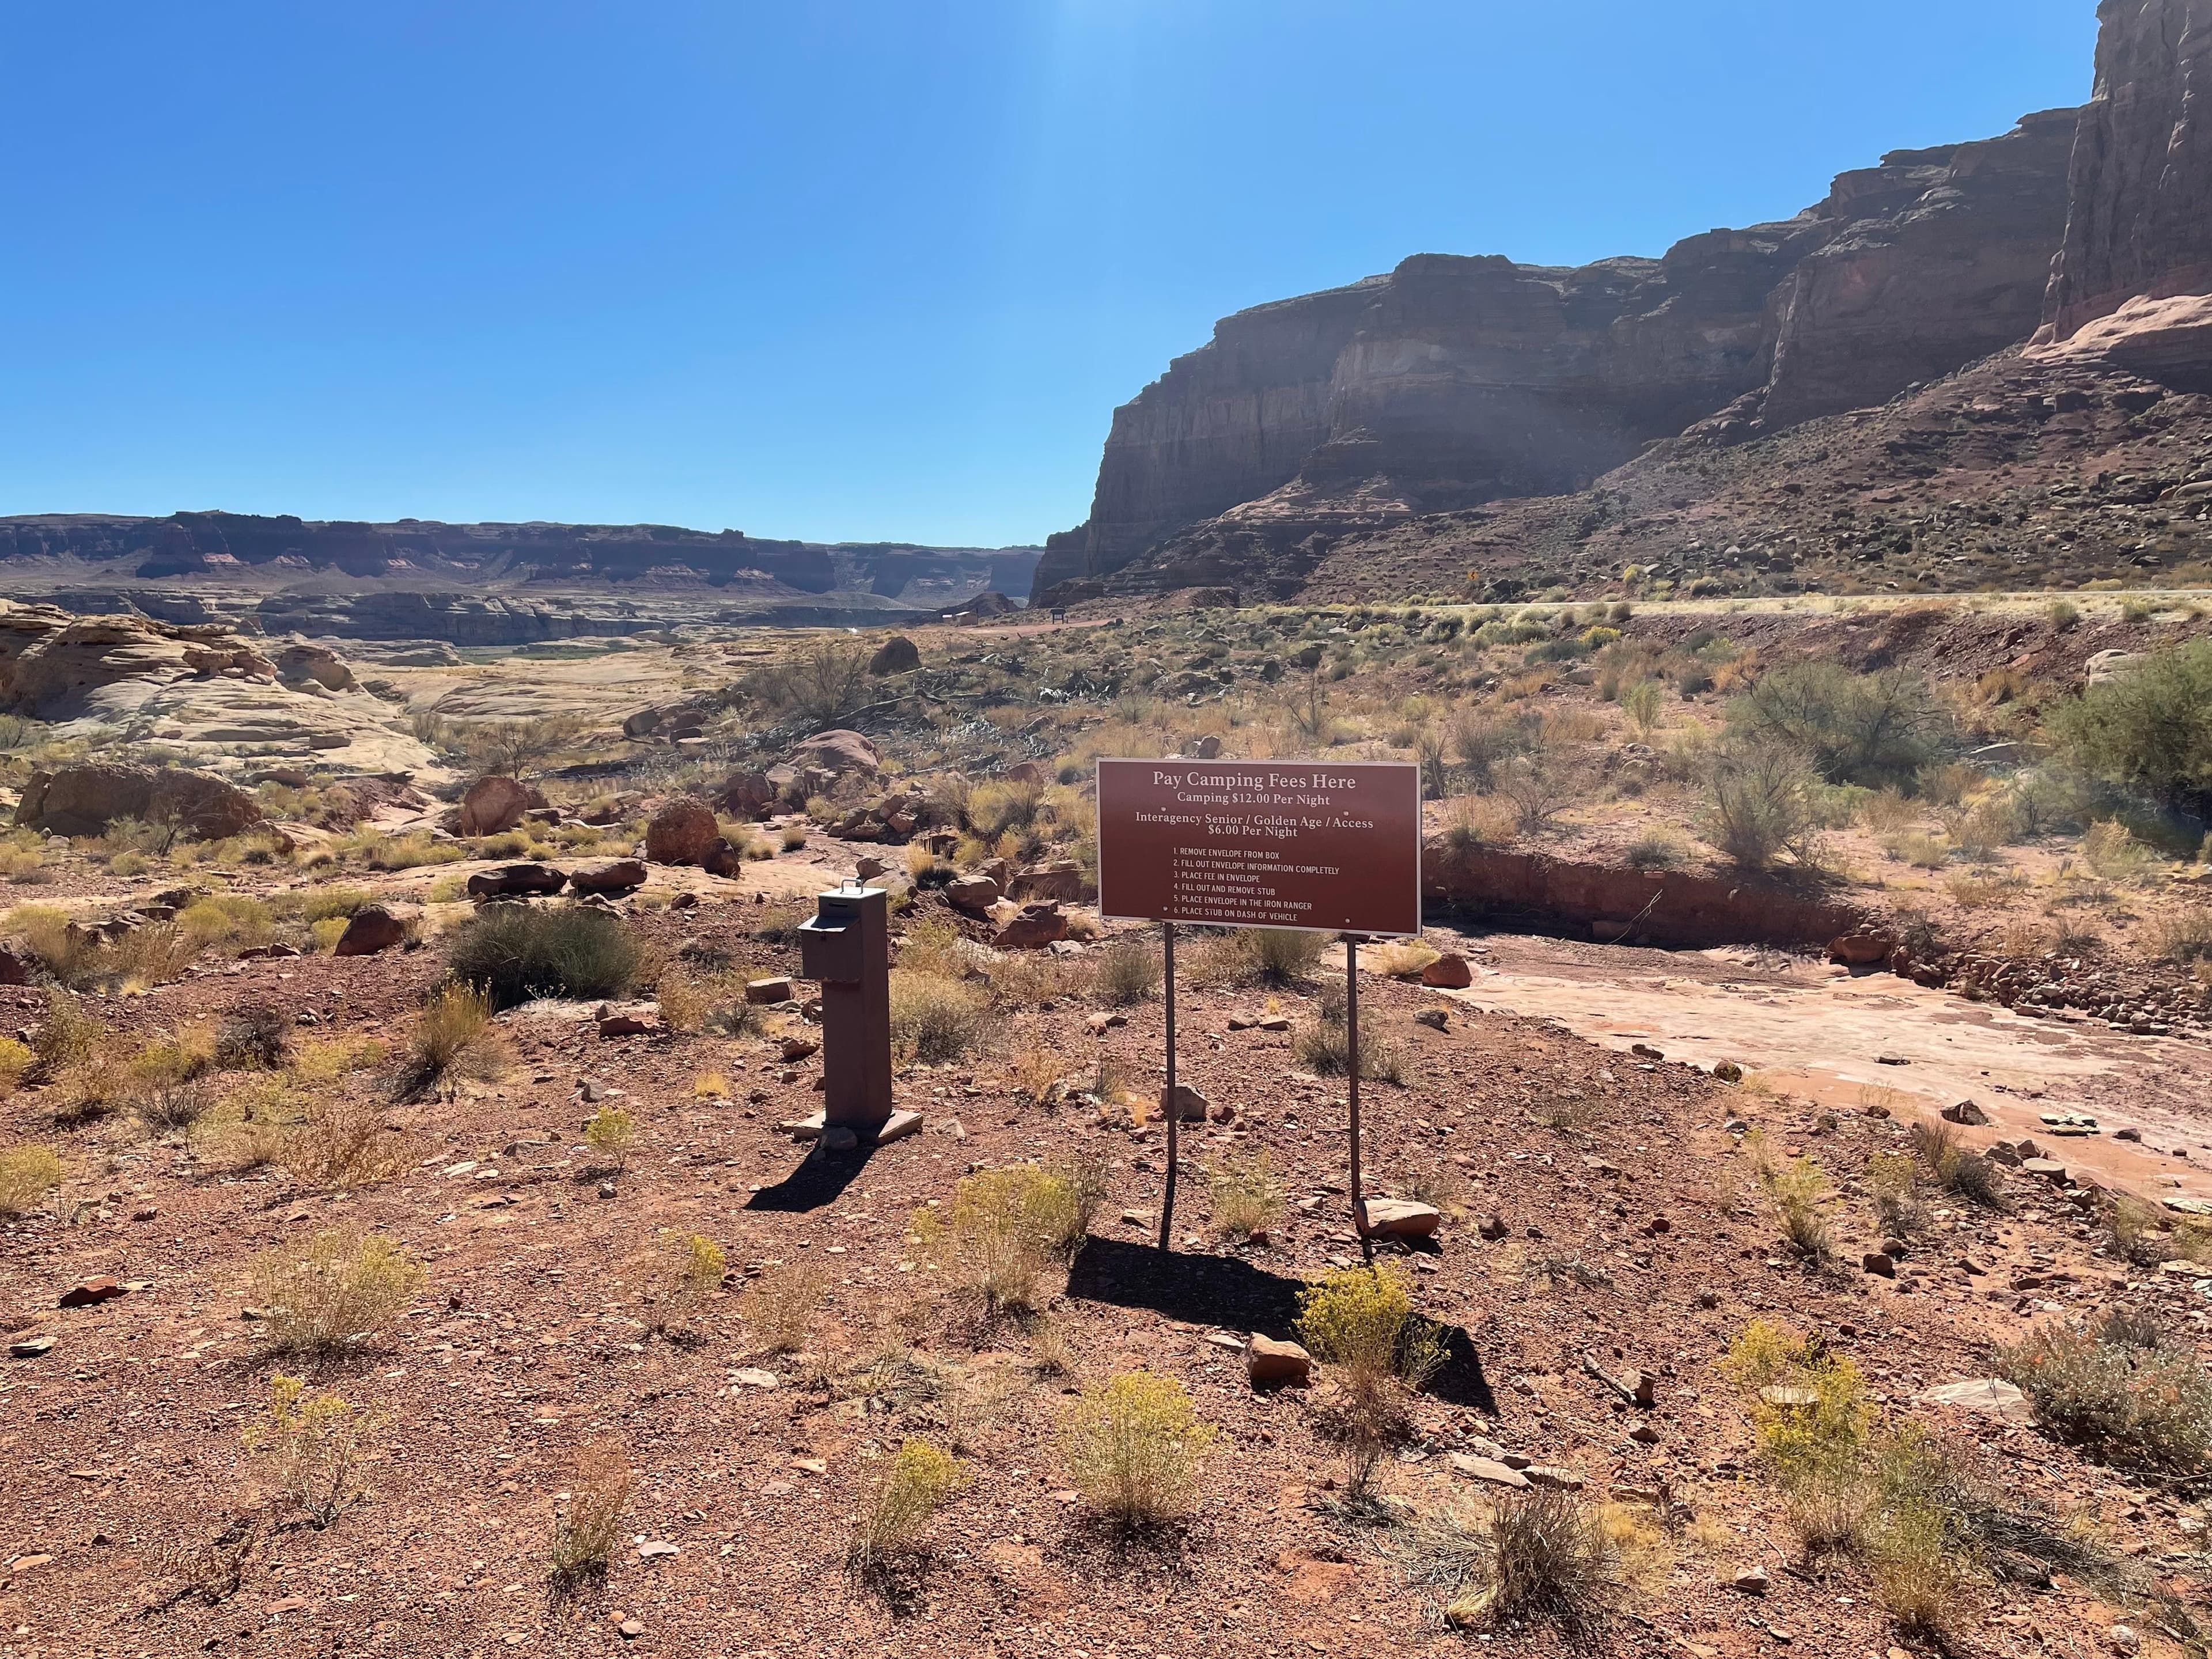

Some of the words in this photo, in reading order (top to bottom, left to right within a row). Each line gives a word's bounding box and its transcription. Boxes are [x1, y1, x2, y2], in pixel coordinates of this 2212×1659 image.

[1153, 771, 1181, 789] Pay
[1187, 772, 1263, 791] Camping
[1268, 773, 1306, 787] Fees
[1312, 774, 1355, 789] Here
[1177, 792, 1229, 805] Camping
[1232, 793, 1269, 803] $12.00
[1274, 794, 1293, 804] Per
[1297, 794, 1330, 808] Night
[1136, 812, 1202, 825] Interagency
[1205, 813, 1243, 824] Senior
[1254, 815, 1297, 825] Golden
[1300, 816, 1322, 830] Age
[1332, 817, 1373, 828] Access
[1209, 824, 1238, 835] $6.00
[1243, 825, 1262, 835] Per
[1265, 826, 1297, 839] Night
[1180, 847, 1206, 856] REMOVE
[1209, 849, 1241, 857] ENVELOPE
[1266, 851, 1279, 859] BOX
[1211, 861, 1245, 870] ENVELOPE
[1247, 863, 1293, 872] INFORMATION
[1296, 865, 1339, 874] COMPLETELY
[1181, 872, 1202, 880] PLACE
[1226, 874, 1260, 882] ENVELOPE
[1228, 886, 1255, 894] REMOVE
[1182, 895, 1202, 903] PLACE
[1205, 896, 1237, 905] ENVELOPE
[1264, 900, 1281, 908] IRON
[1283, 902, 1312, 910] RANGER
[1182, 907, 1203, 915] PLACE
[1237, 910, 1256, 918] DASH
[1270, 912, 1297, 921] VEHICLE
